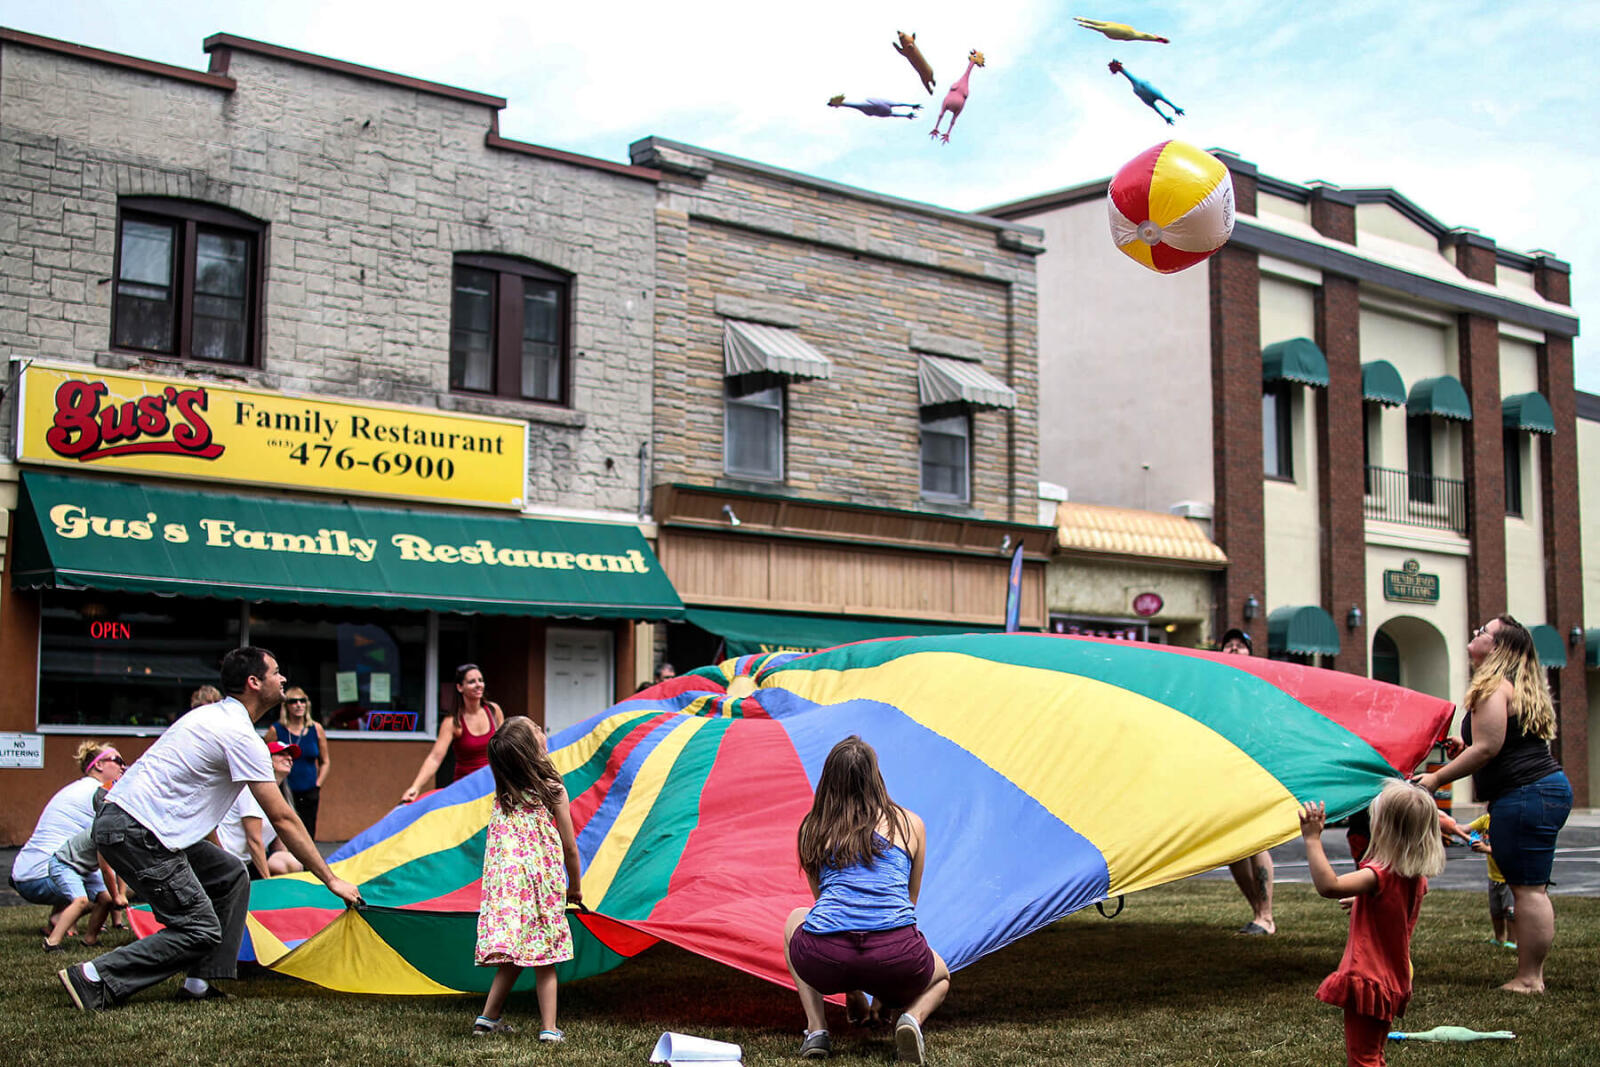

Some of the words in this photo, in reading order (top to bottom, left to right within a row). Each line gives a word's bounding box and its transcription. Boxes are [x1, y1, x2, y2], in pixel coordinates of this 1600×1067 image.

[235, 401, 339, 441] Family
[351, 415, 504, 455] Restaurant
[289, 442, 455, 481] 476-6900
[50, 504, 190, 543] Gus's
[199, 518, 378, 562] Family
[391, 534, 650, 574] Restaurant
[90, 620, 131, 640] OPEN
[370, 713, 416, 731] OPEN
[14, 741, 26, 749] NO
